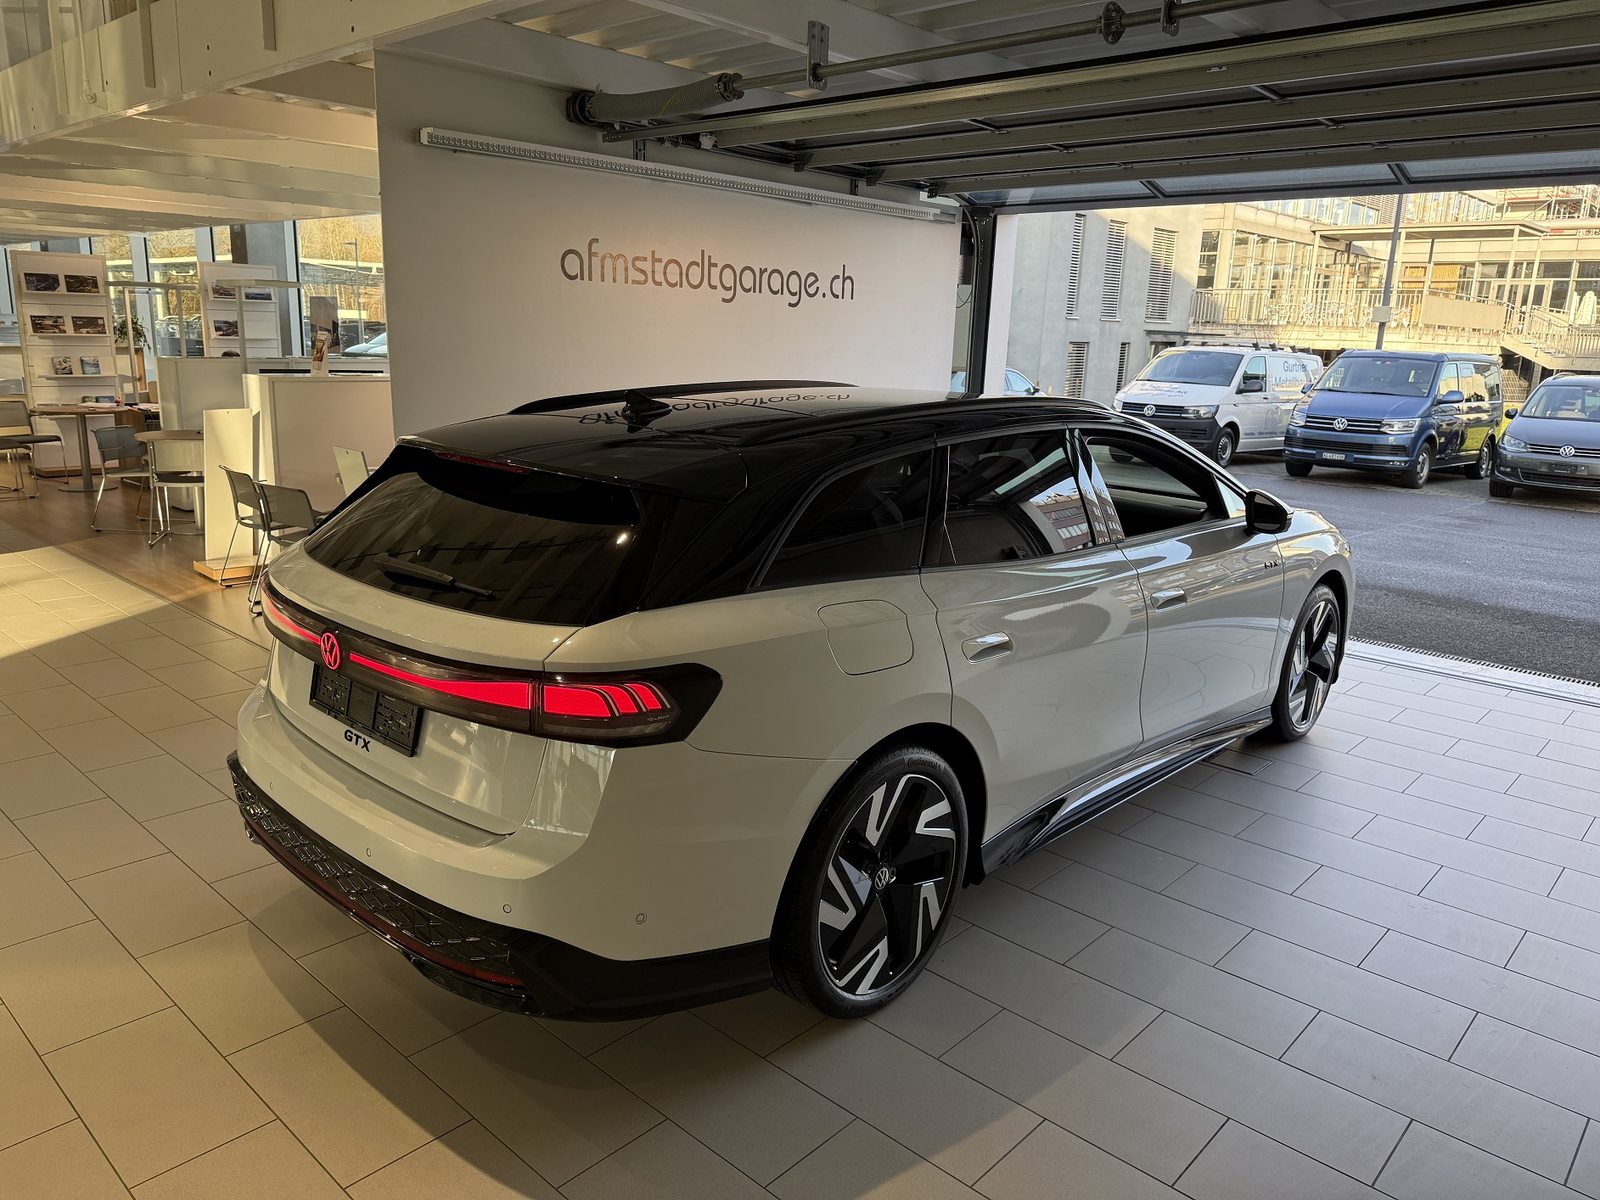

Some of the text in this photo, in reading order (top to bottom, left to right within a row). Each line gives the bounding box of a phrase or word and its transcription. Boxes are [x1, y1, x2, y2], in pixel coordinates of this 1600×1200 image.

[560, 237, 855, 308] afmstadtgarage.ch
[344, 729, 371, 752] GTX
[907, 757, 938, 769] Continental
